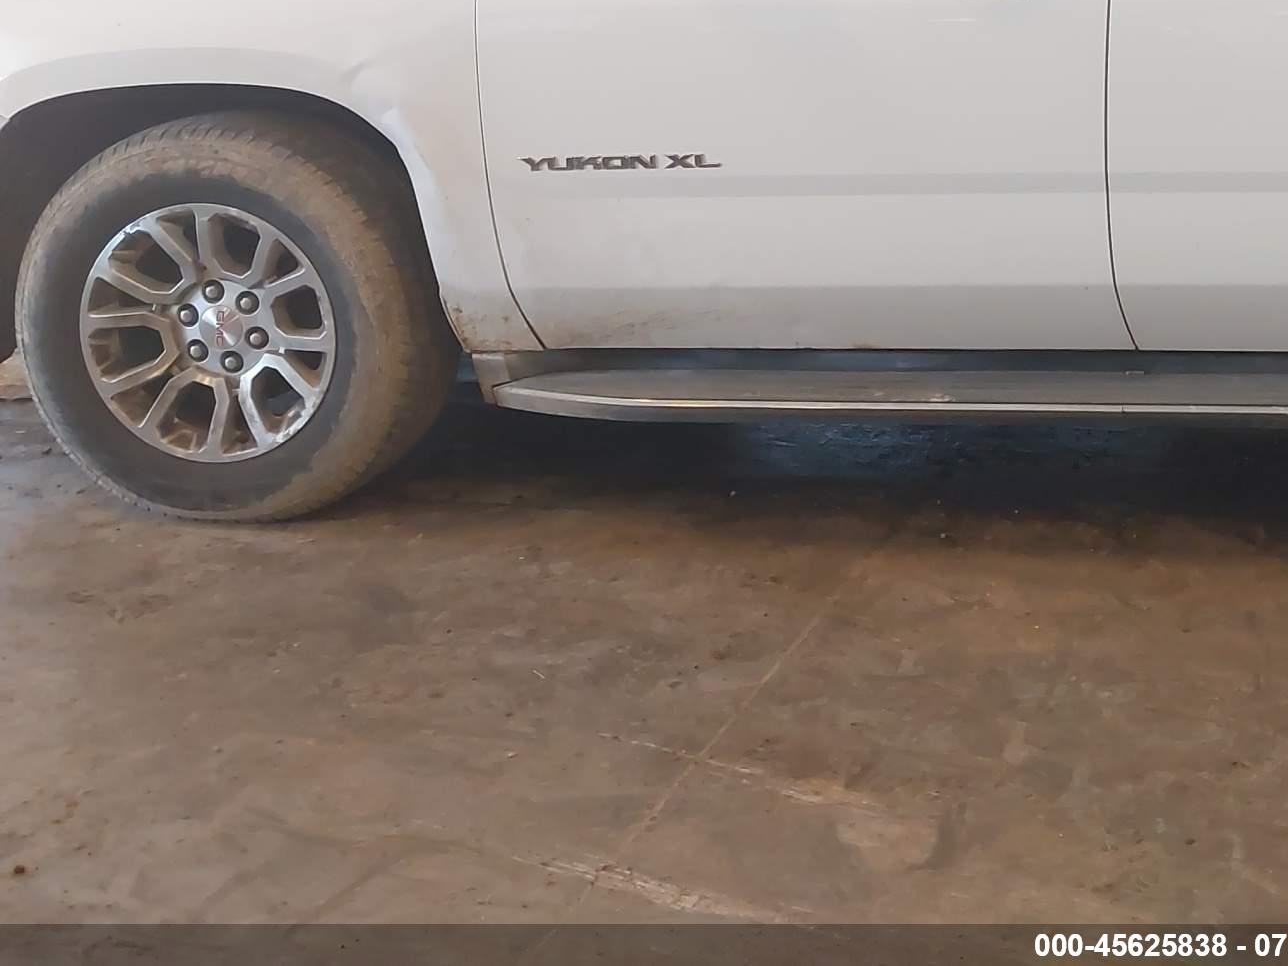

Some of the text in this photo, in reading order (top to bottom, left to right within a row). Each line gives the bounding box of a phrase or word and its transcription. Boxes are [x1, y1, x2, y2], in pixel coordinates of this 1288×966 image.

[518, 153, 722, 171] YUKON XL
[215, 310, 224, 347] GMC
